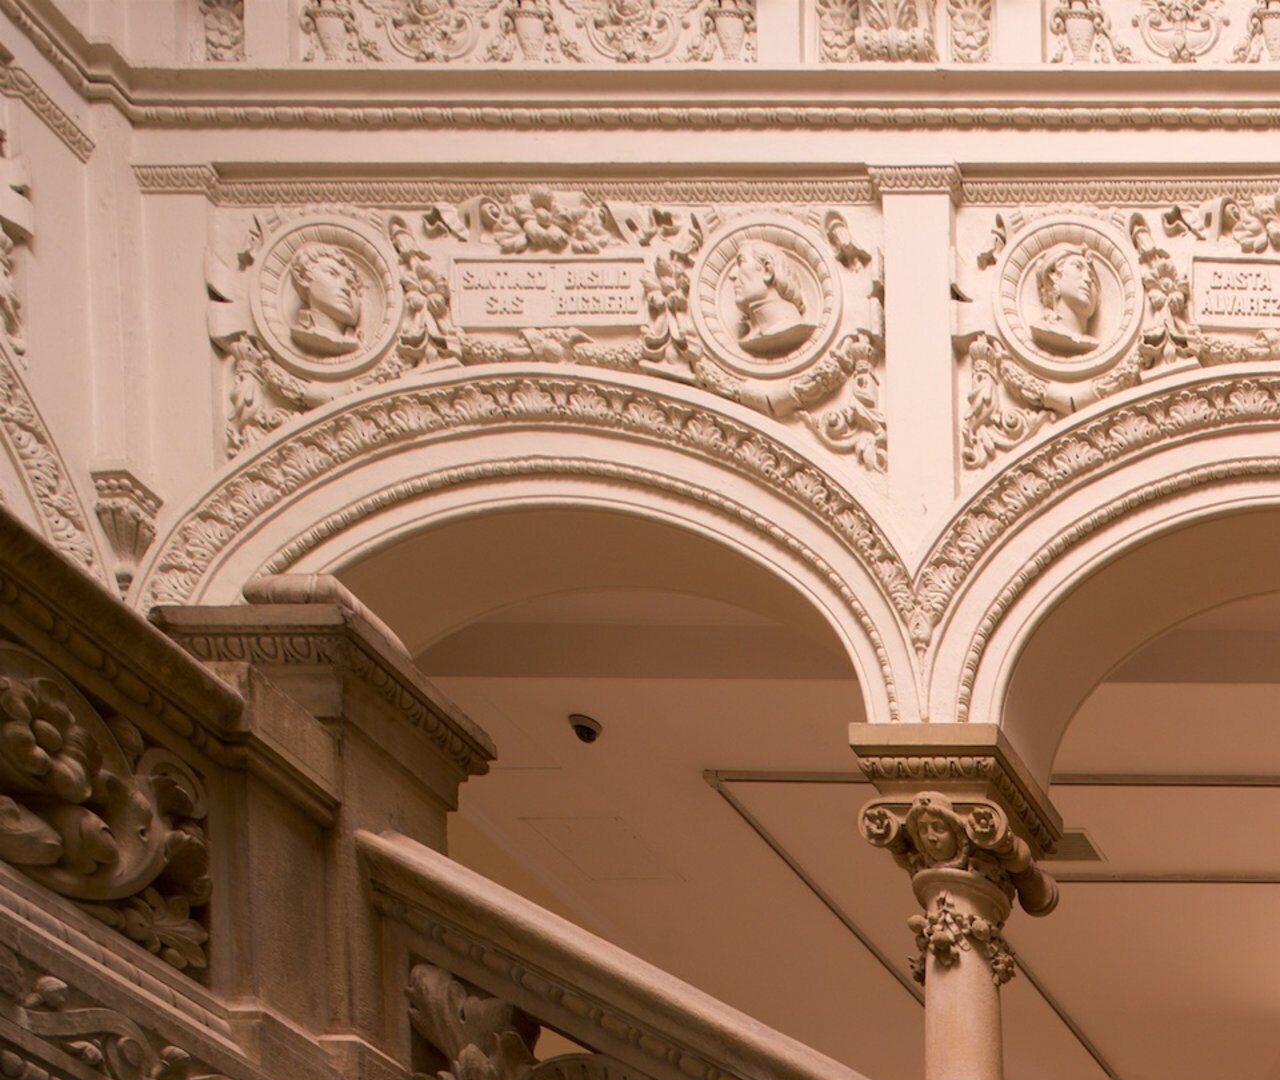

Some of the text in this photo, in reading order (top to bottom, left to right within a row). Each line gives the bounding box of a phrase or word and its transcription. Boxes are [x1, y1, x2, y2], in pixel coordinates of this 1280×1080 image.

[462, 271, 546, 290] SANTIAGO
[564, 270, 631, 290] BASILIO
[1210, 271, 1272, 291] CASTA
[486, 295, 525, 315] SAS
